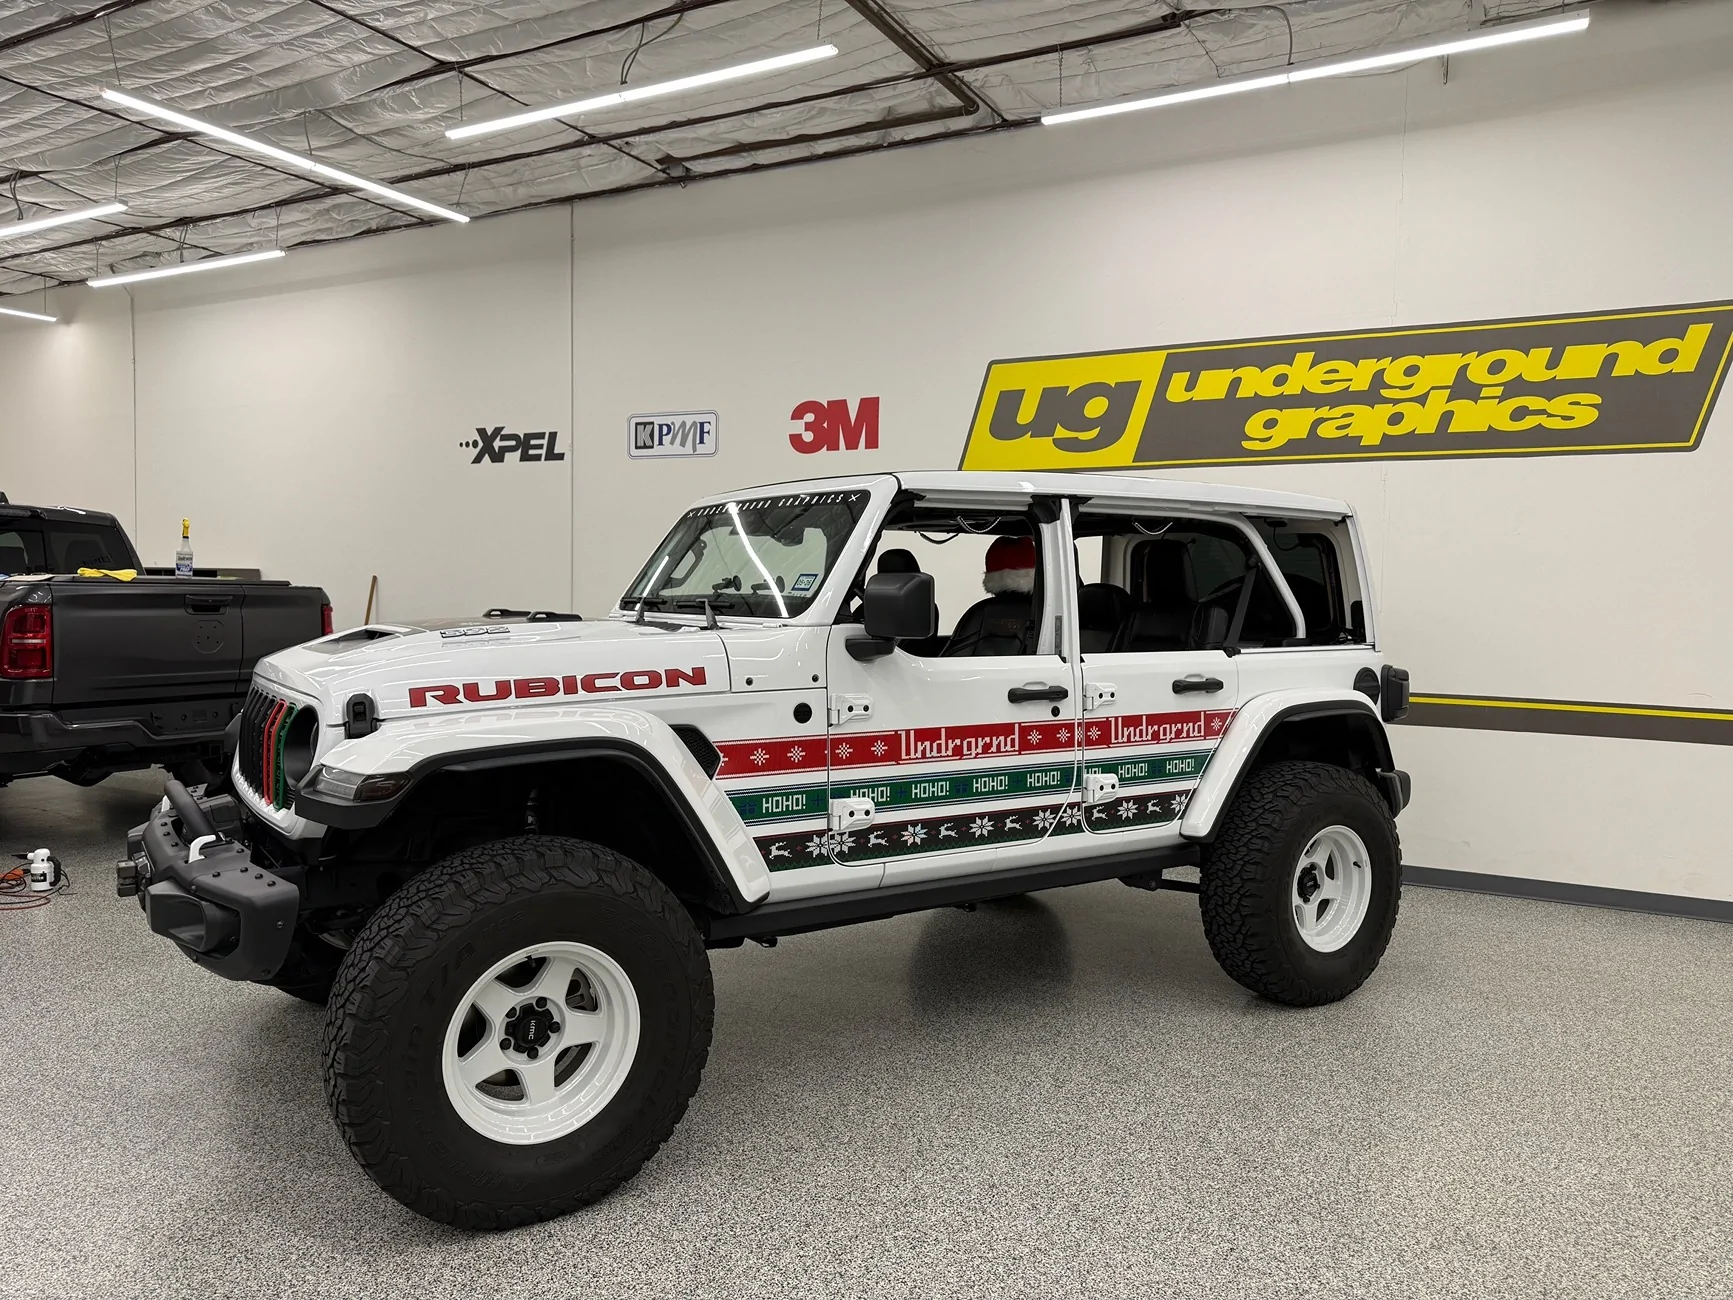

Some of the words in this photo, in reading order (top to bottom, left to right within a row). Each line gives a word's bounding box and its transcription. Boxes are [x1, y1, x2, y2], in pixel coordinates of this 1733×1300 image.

[1165, 322, 1714, 403] underground
[634, 420, 712, 456] KPMF
[788, 396, 881, 455] 3M
[988, 380, 1141, 453] ug
[1240, 386, 1602, 452] graphics
[470, 425, 566, 465] XPEL
[408, 666, 707, 708] RUBICON
[898, 723, 1019, 760] Undrgrnd
[1109, 711, 1205, 744] Undrgrnd
[762, 794, 806, 814] HOHO!
[911, 781, 950, 799] HOHO!
[972, 775, 1009, 793] HOHO!
[1027, 770, 1061, 787] HOHO!
[1118, 762, 1148, 779] HOHO!
[1166, 758, 1195, 774] HOHO!
